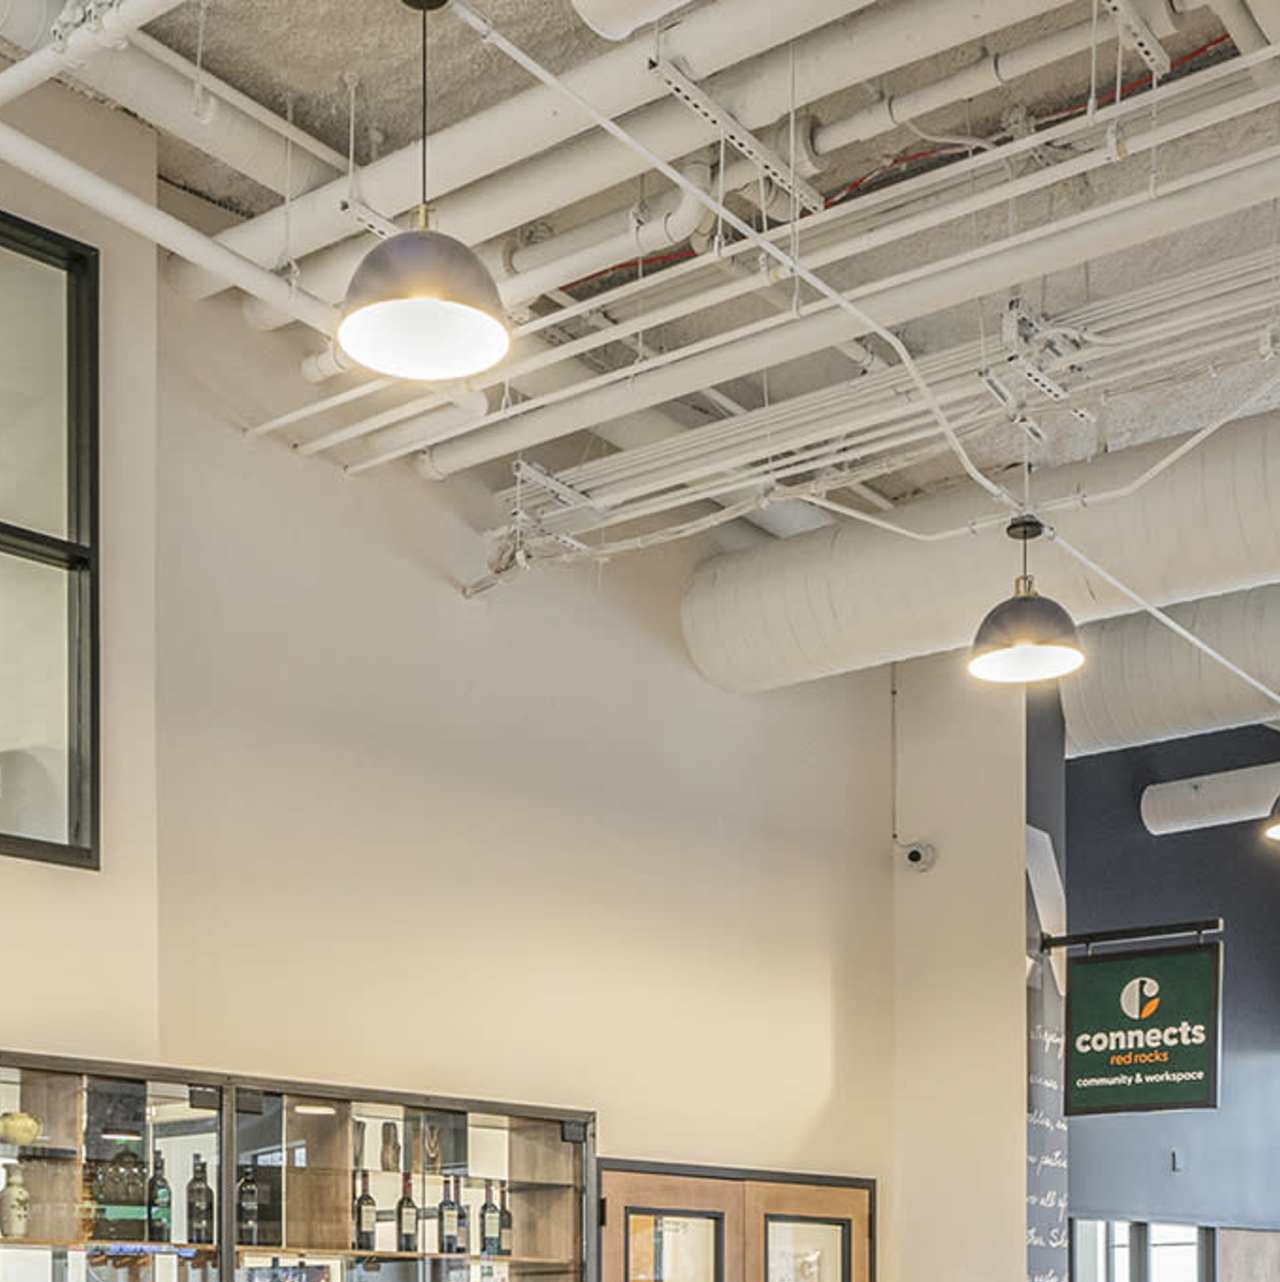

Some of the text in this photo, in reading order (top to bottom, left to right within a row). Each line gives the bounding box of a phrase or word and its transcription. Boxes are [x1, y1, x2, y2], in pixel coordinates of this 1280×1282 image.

[1075, 1021, 1206, 1052] connects
[1110, 1050, 1169, 1065] red rocks
[1076, 1070, 1205, 1088] community & workspace
